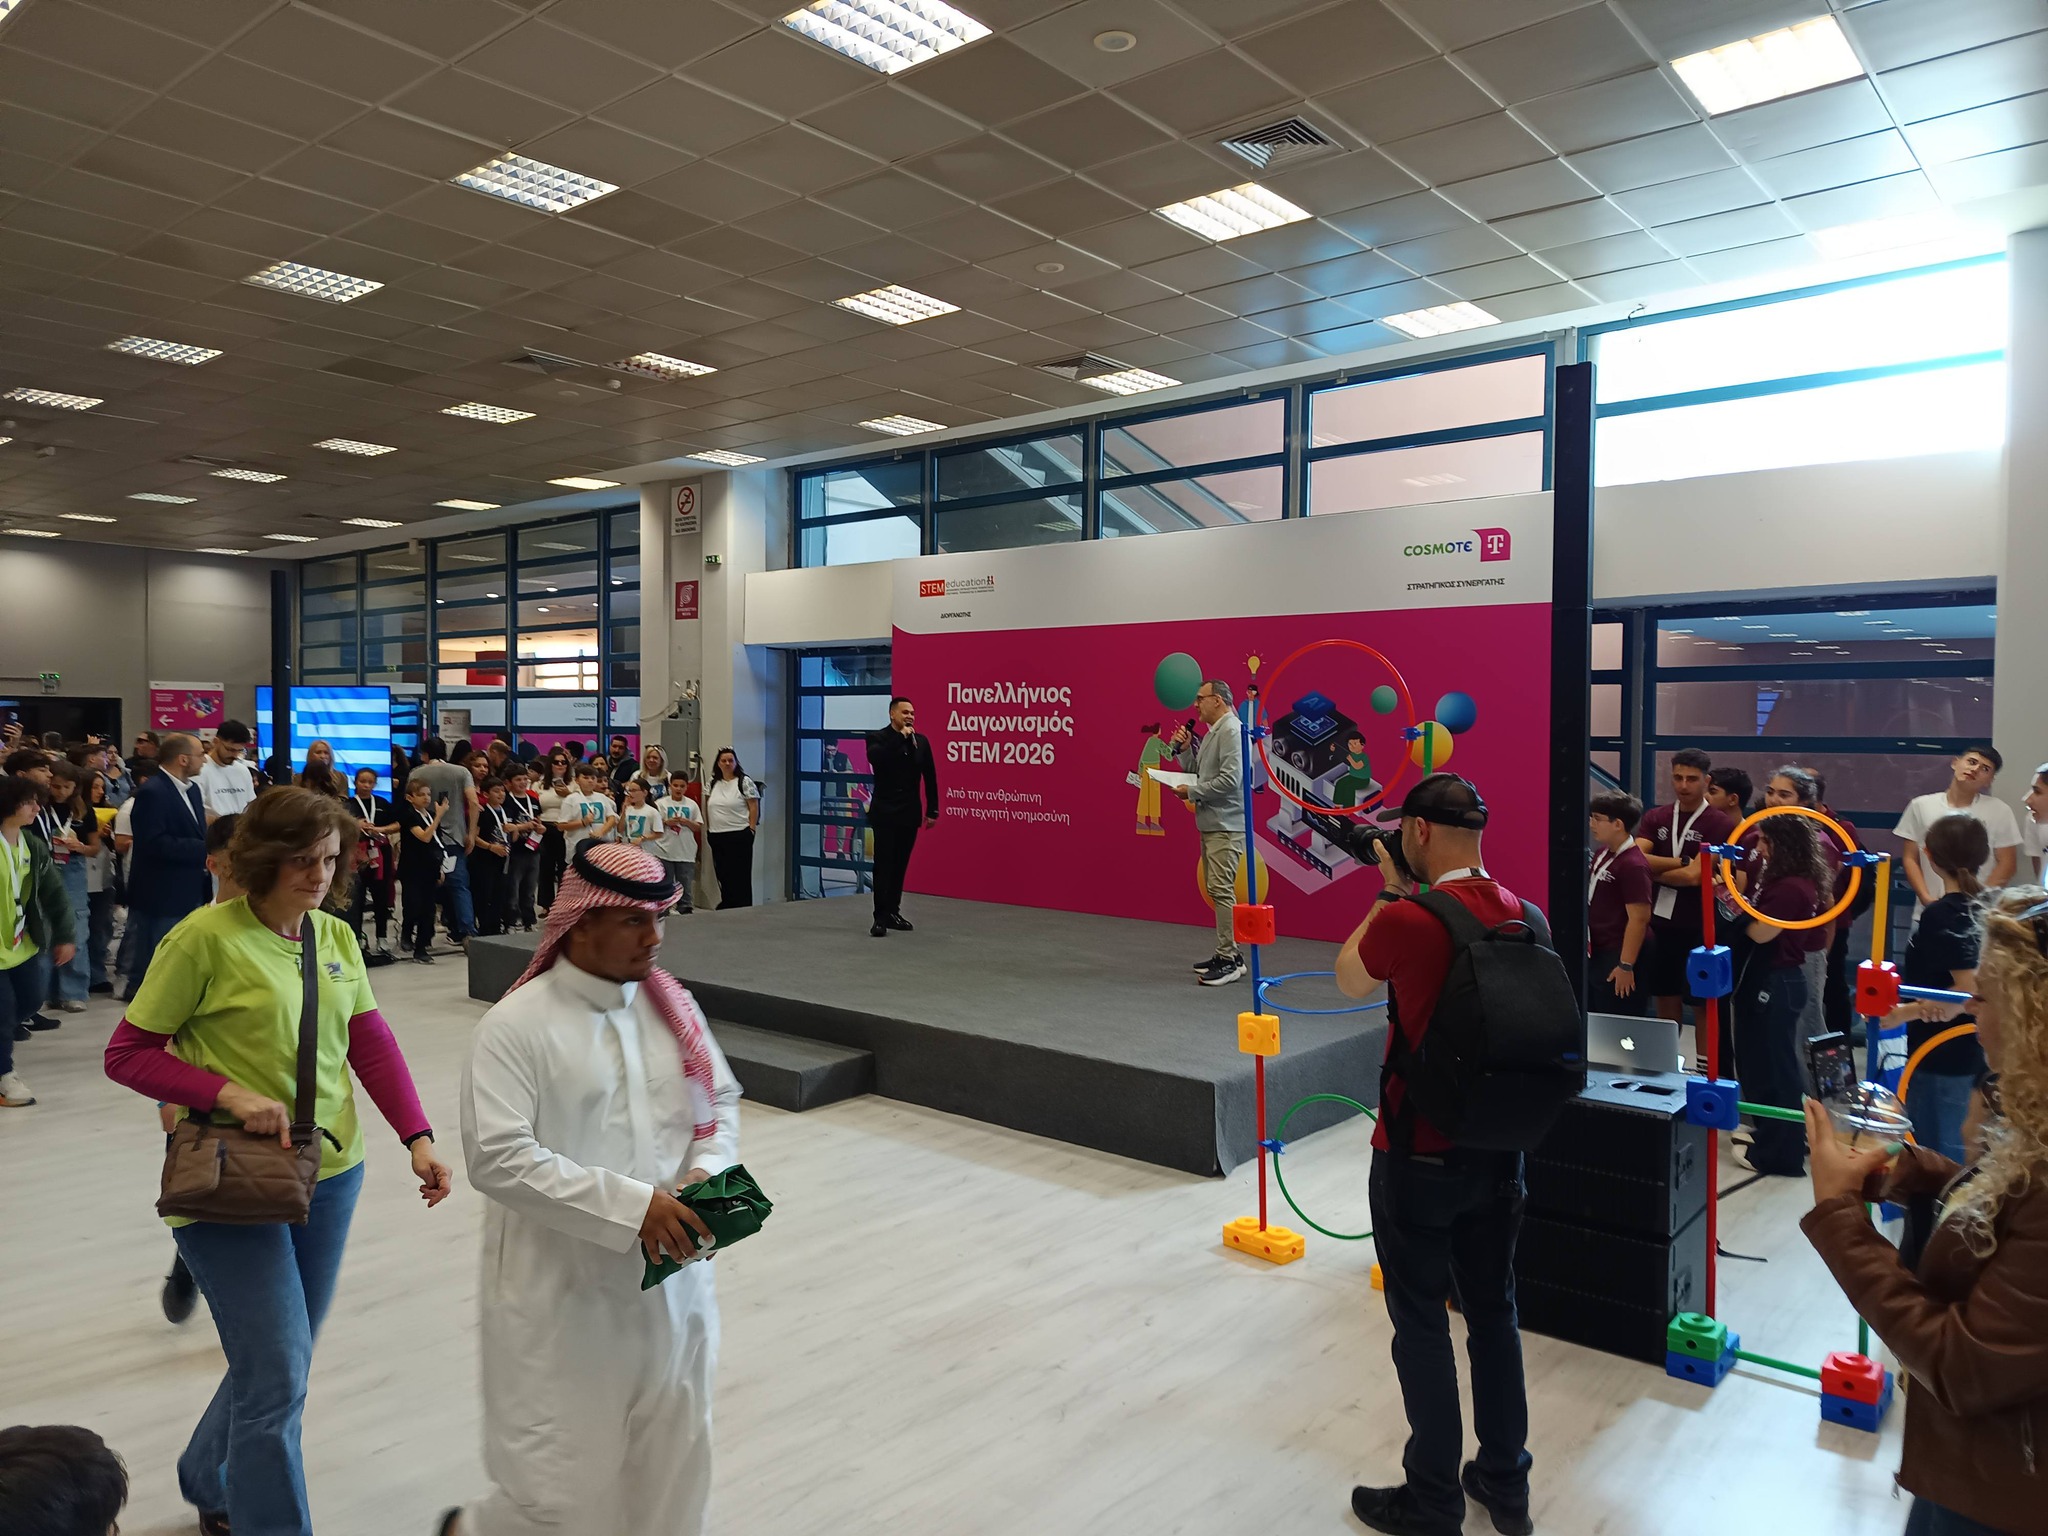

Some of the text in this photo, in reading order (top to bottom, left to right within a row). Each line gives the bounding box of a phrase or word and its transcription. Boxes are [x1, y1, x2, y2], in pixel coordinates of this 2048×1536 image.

[1403, 541, 1473, 557] COSMOTE
[920, 577, 986, 595] STEM education
[1407, 578, 1506, 590] ΣΤΡΑΤΗΓΙΚΟΣ ΣΥΝΕΡΓΑΤΗΣ
[947, 681, 1072, 709] Πανελλήνιος
[946, 710, 1074, 738] Διαγωνισμός
[946, 741, 1055, 765] STEM 2026
[946, 787, 1042, 806] Από την ανθρώπινη
[946, 806, 1070, 826] στην τεχνητή νοημοσύνη
